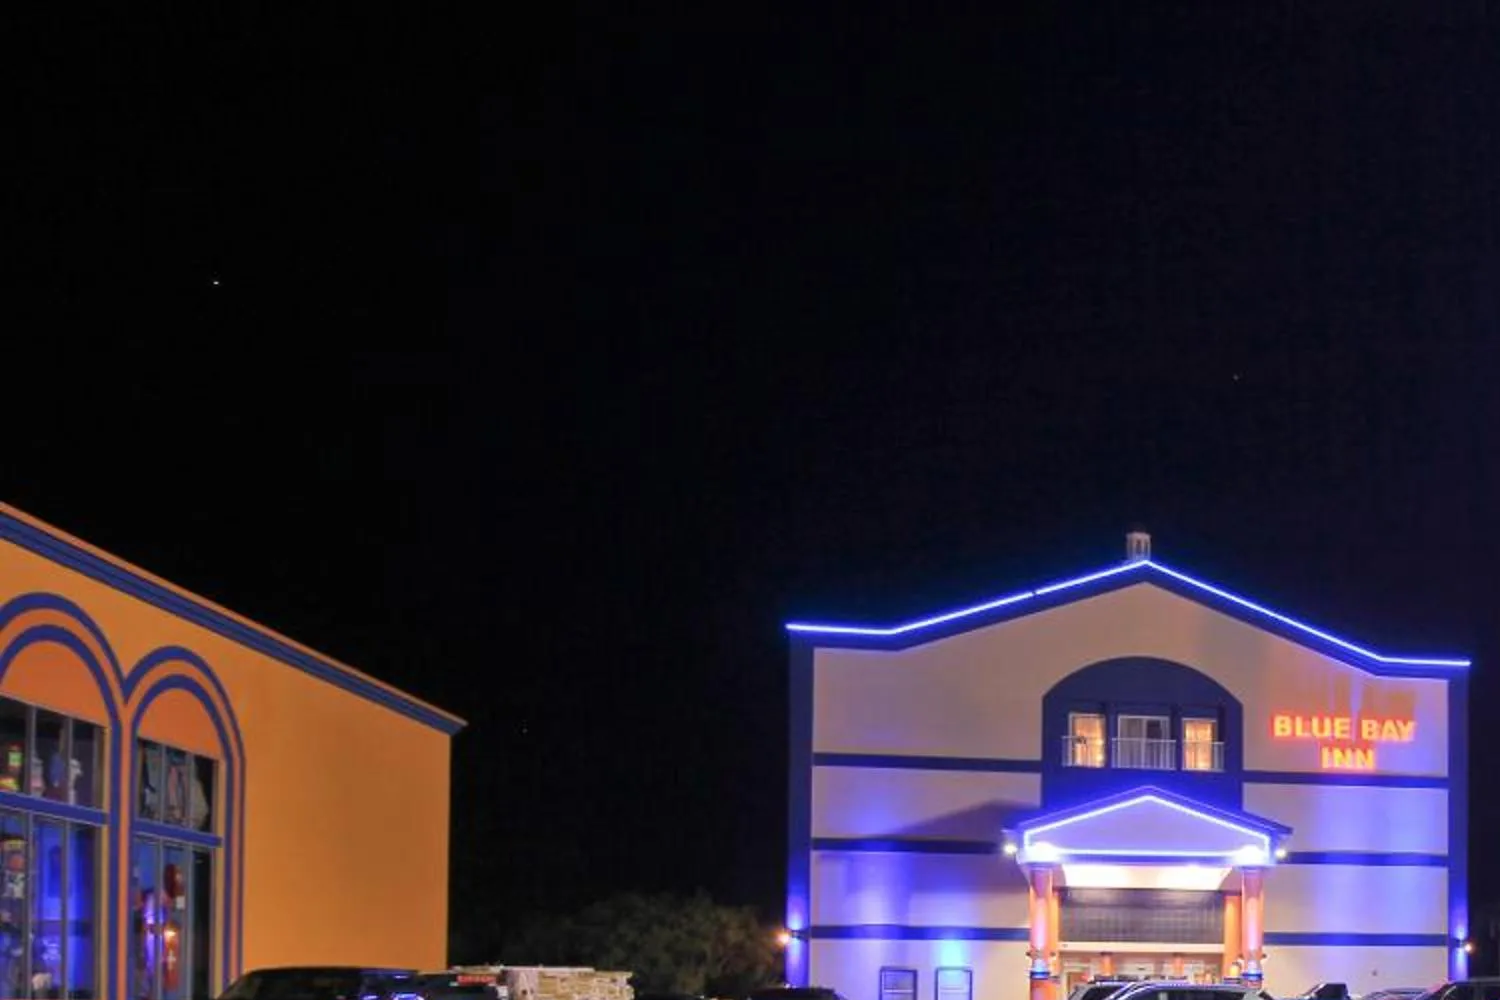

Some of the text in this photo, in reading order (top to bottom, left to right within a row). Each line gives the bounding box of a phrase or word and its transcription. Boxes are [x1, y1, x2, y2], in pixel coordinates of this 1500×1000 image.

[1273, 715, 1416, 742] BLUE BAY
[1320, 747, 1375, 769] INN
